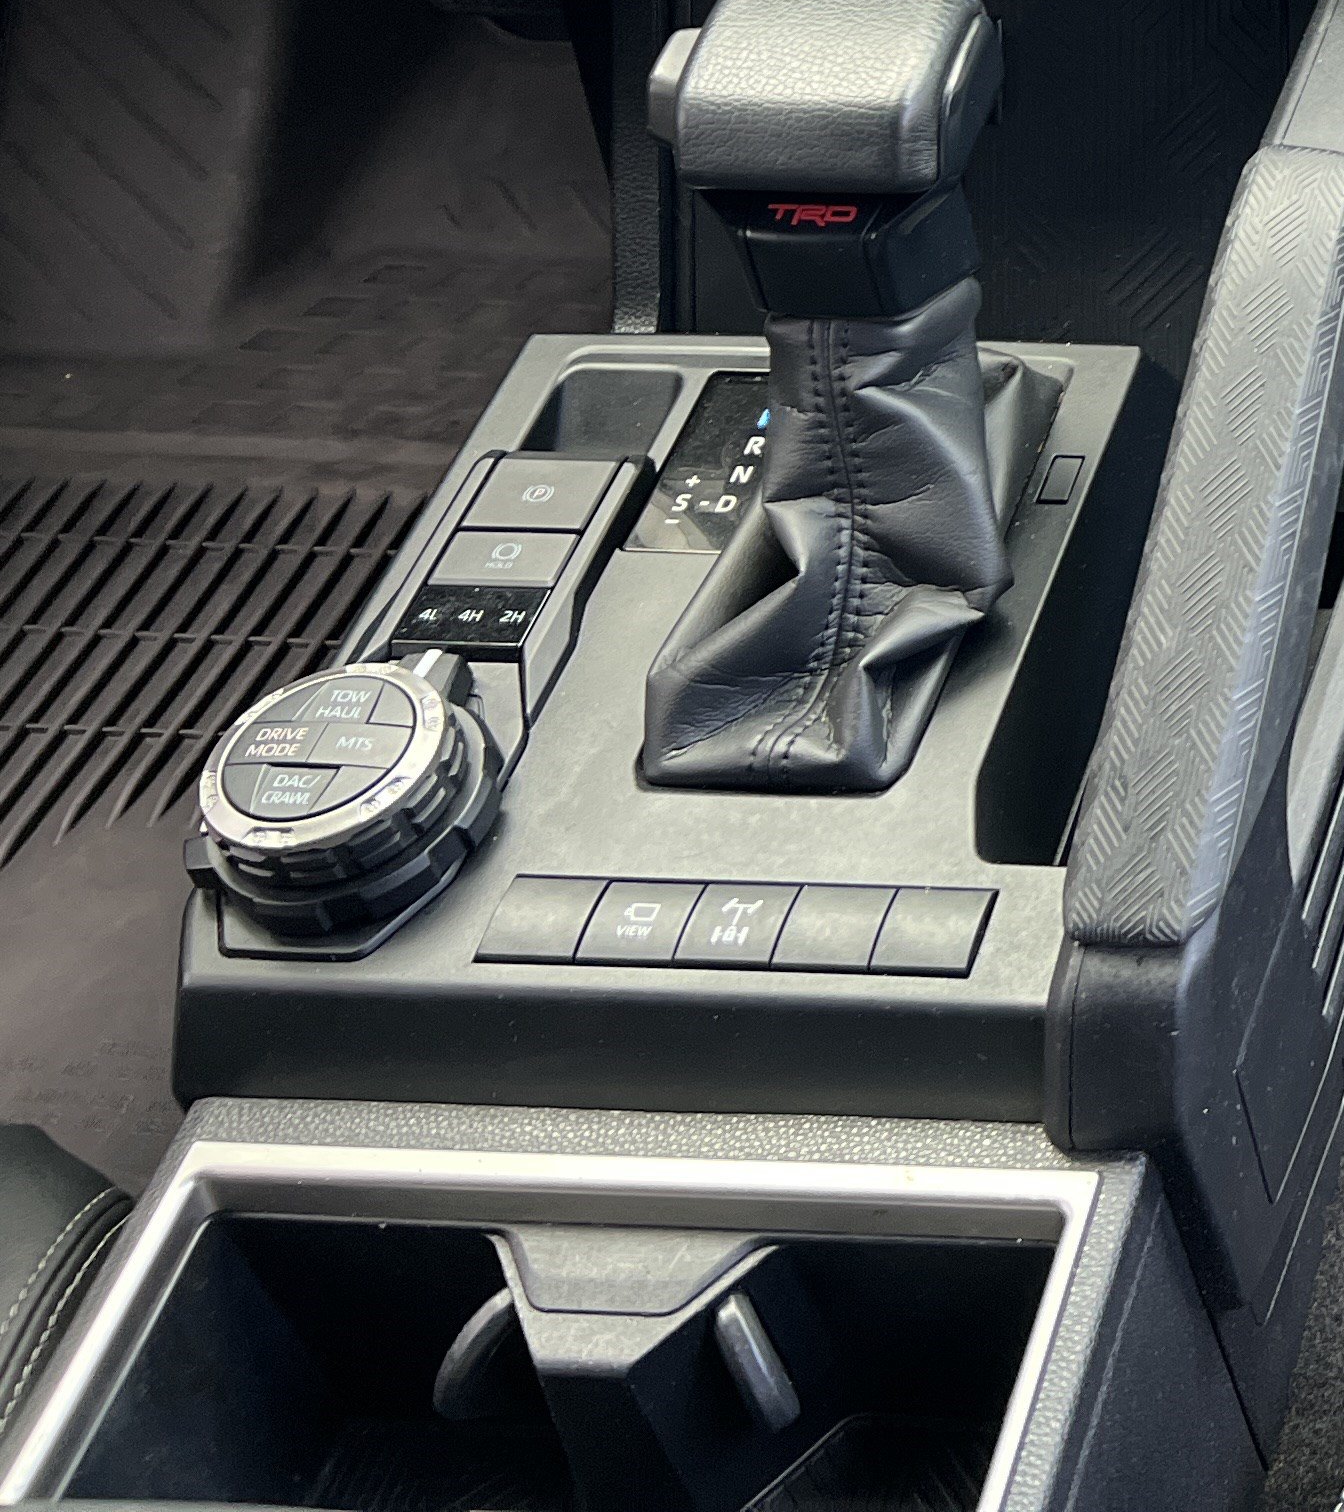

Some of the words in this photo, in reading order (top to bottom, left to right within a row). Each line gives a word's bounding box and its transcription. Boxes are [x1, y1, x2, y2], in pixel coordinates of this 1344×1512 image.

[767, 203, 859, 227] TRD
[743, 435, 766, 456] R
[729, 465, 754, 484] N
[418, 608, 439, 621] 4L
[457, 609, 485, 622] 4H
[499, 609, 527, 623] 2H
[329, 689, 373, 703] TOW
[314, 705, 363, 719] HAUL
[254, 727, 310, 742] DRIVE
[244, 743, 302, 758] MODE
[334, 735, 376, 751] MTS
[260, 790, 311, 805] CRAWL
[615, 924, 653, 939] VIEW
